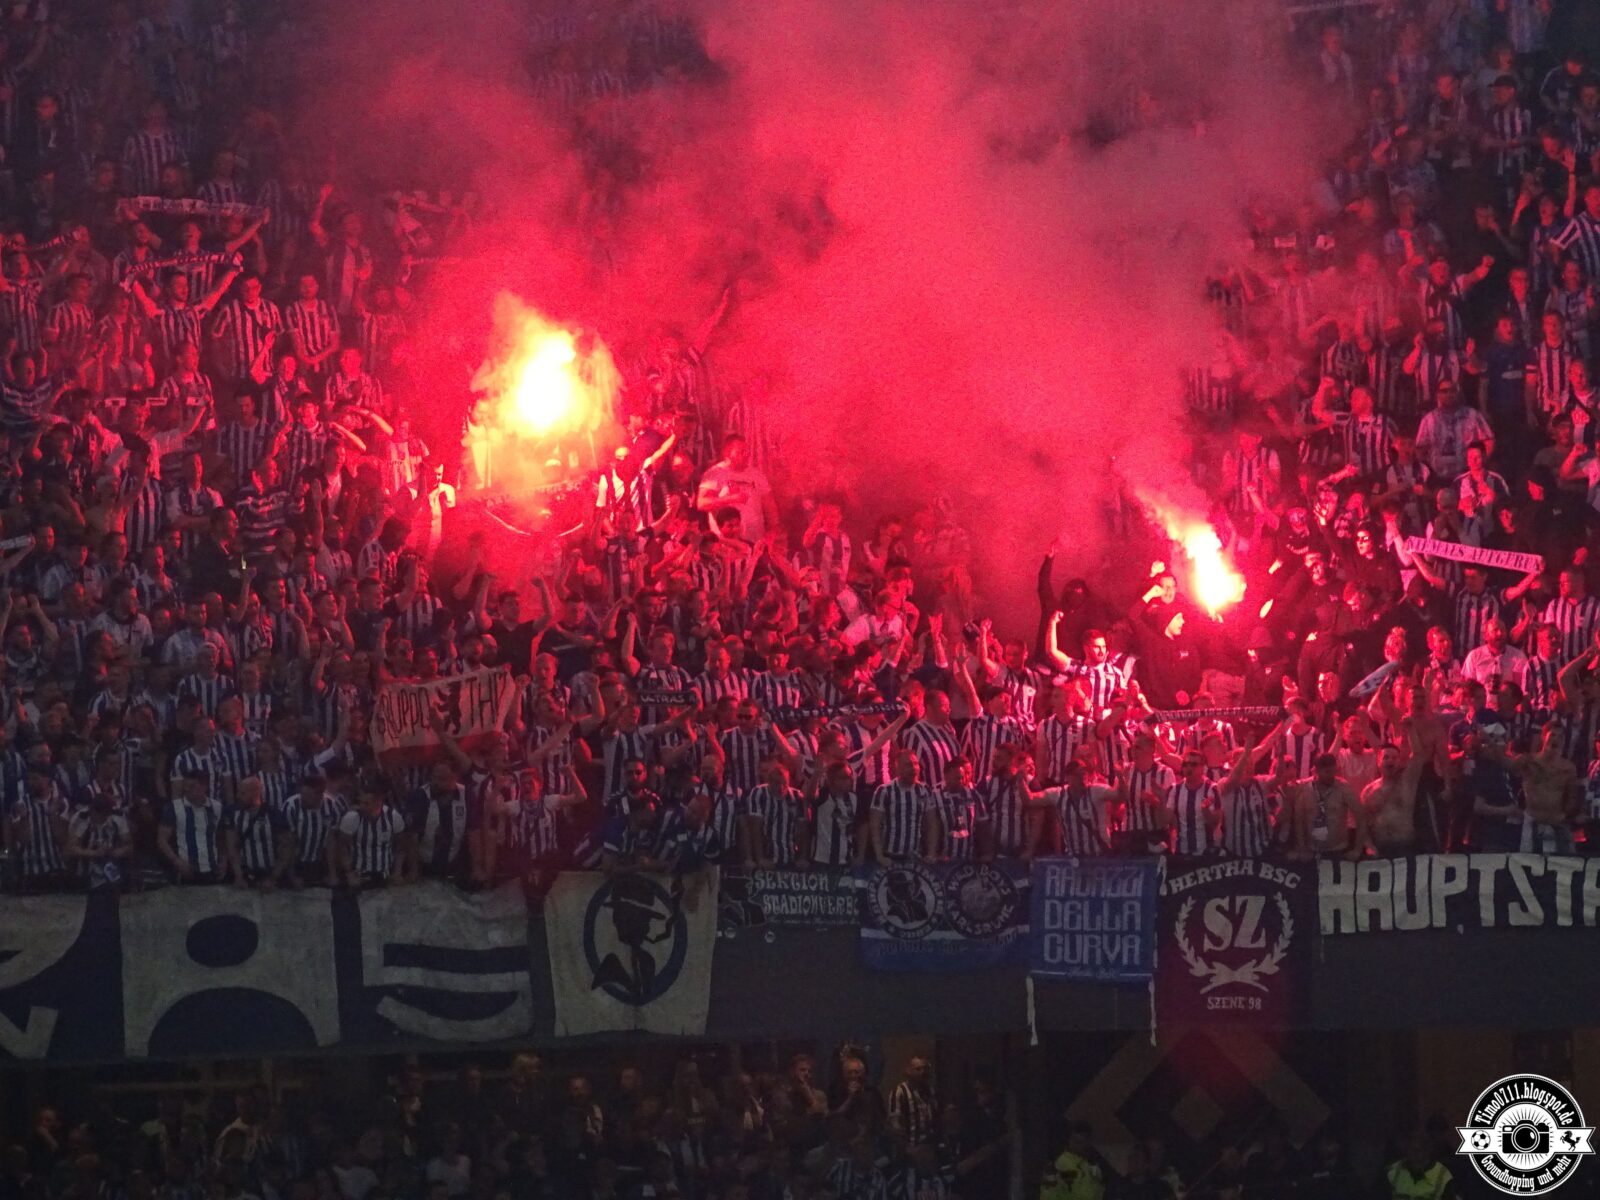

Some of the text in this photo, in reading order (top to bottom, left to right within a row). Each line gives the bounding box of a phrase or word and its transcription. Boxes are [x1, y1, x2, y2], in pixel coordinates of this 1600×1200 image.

[980, 864, 1012, 895] BOYS
[1168, 858, 1302, 893] HERTHA BSC
[1044, 899, 1141, 931] DELLA
[1202, 895, 1267, 952] SZ
[1044, 933, 1140, 966] CURVA
[1206, 996, 1263, 1010] SZENE 98
